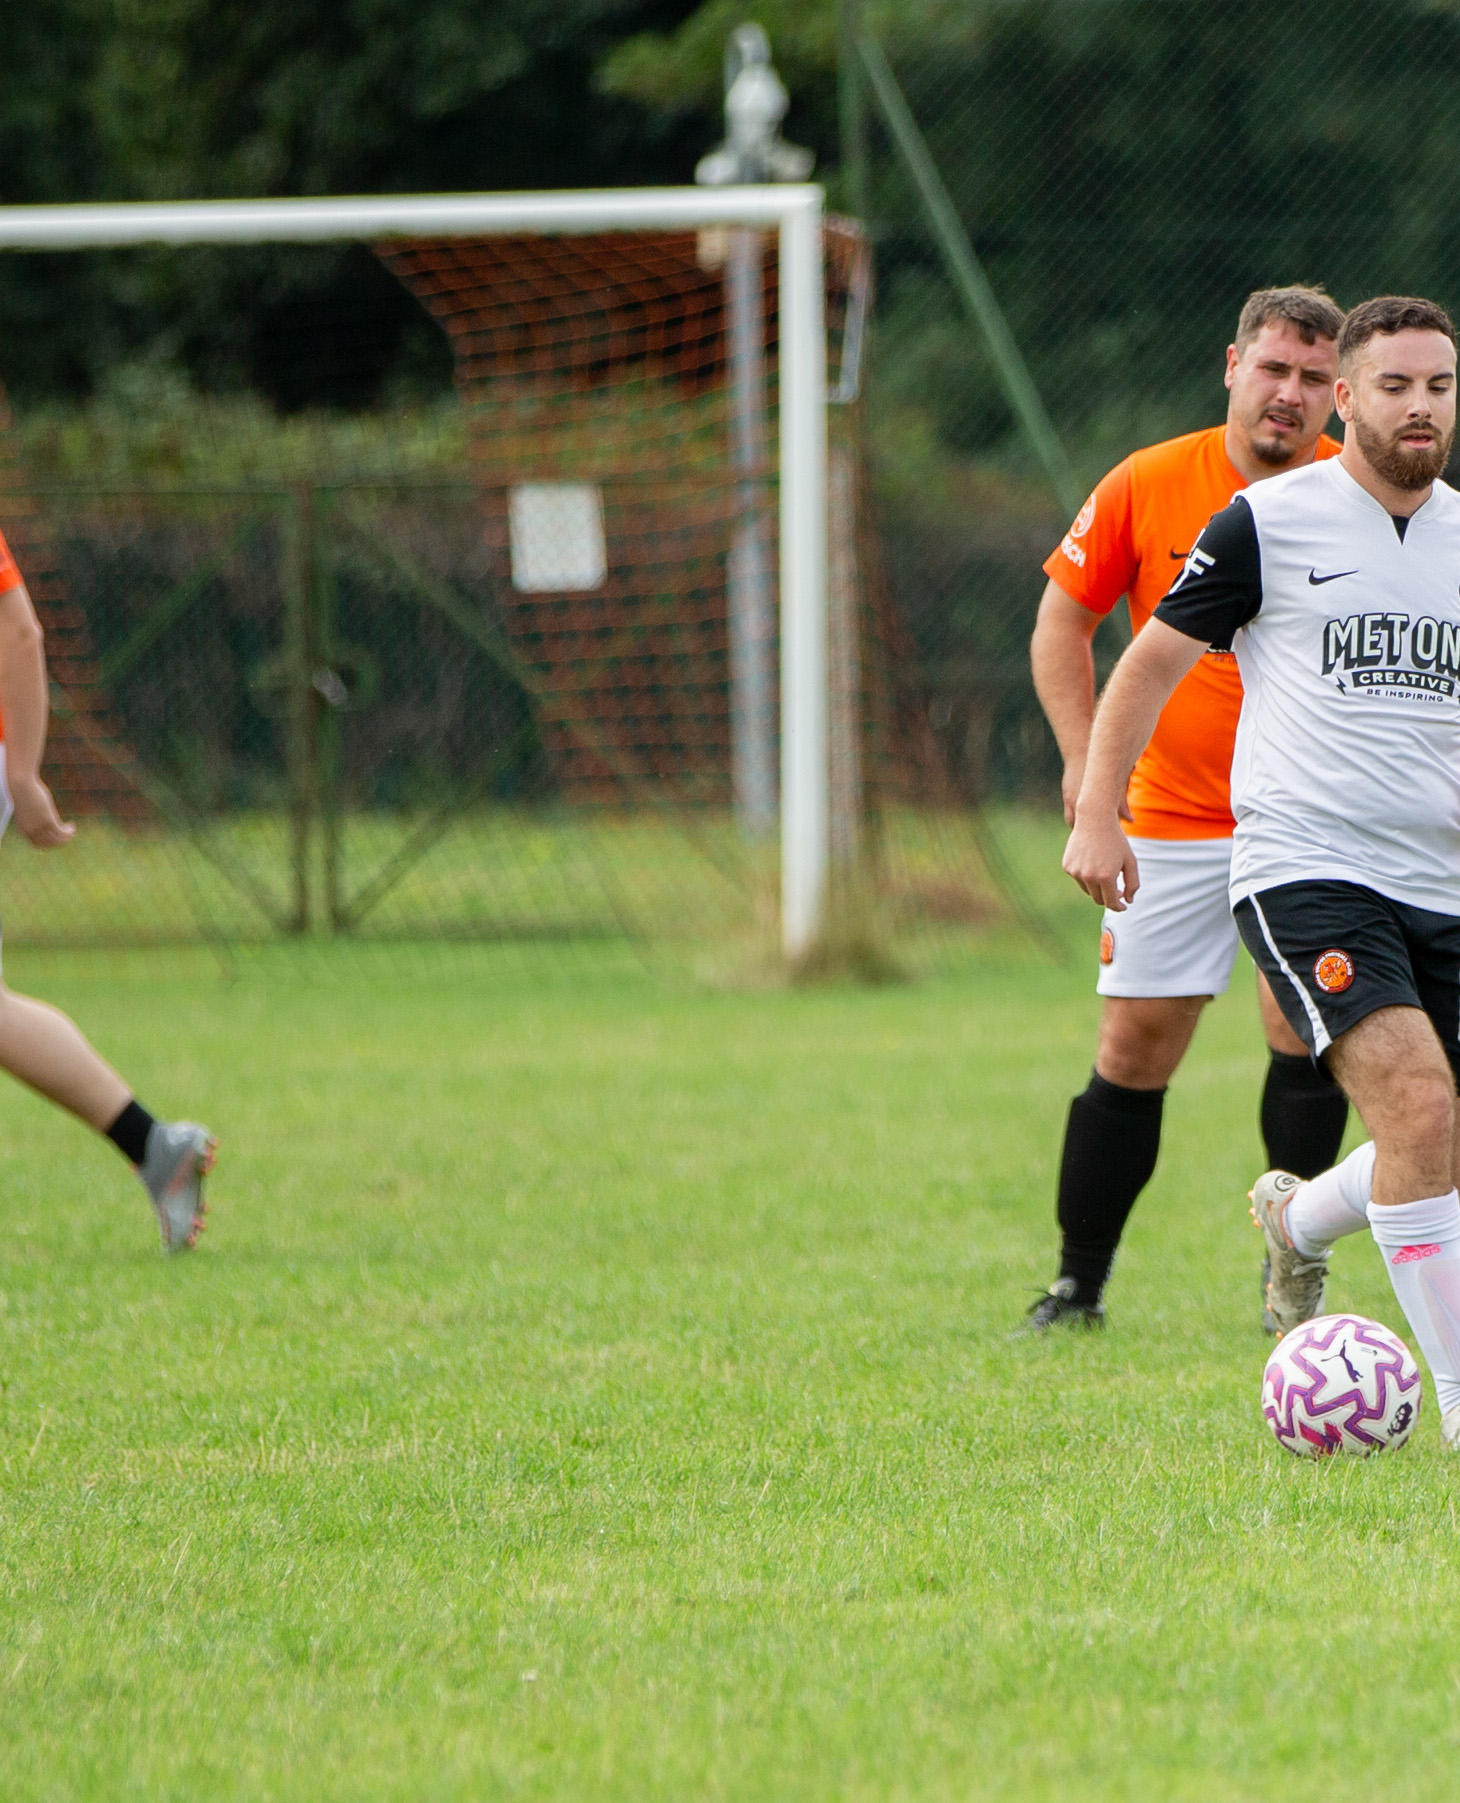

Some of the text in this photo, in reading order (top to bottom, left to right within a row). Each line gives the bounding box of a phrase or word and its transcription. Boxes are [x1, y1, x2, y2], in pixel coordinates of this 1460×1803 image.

[1321, 612, 1411, 676] MET
[1358, 671, 1450, 694] CREATIVE
[1366, 688, 1444, 703] BE INSPIRING
